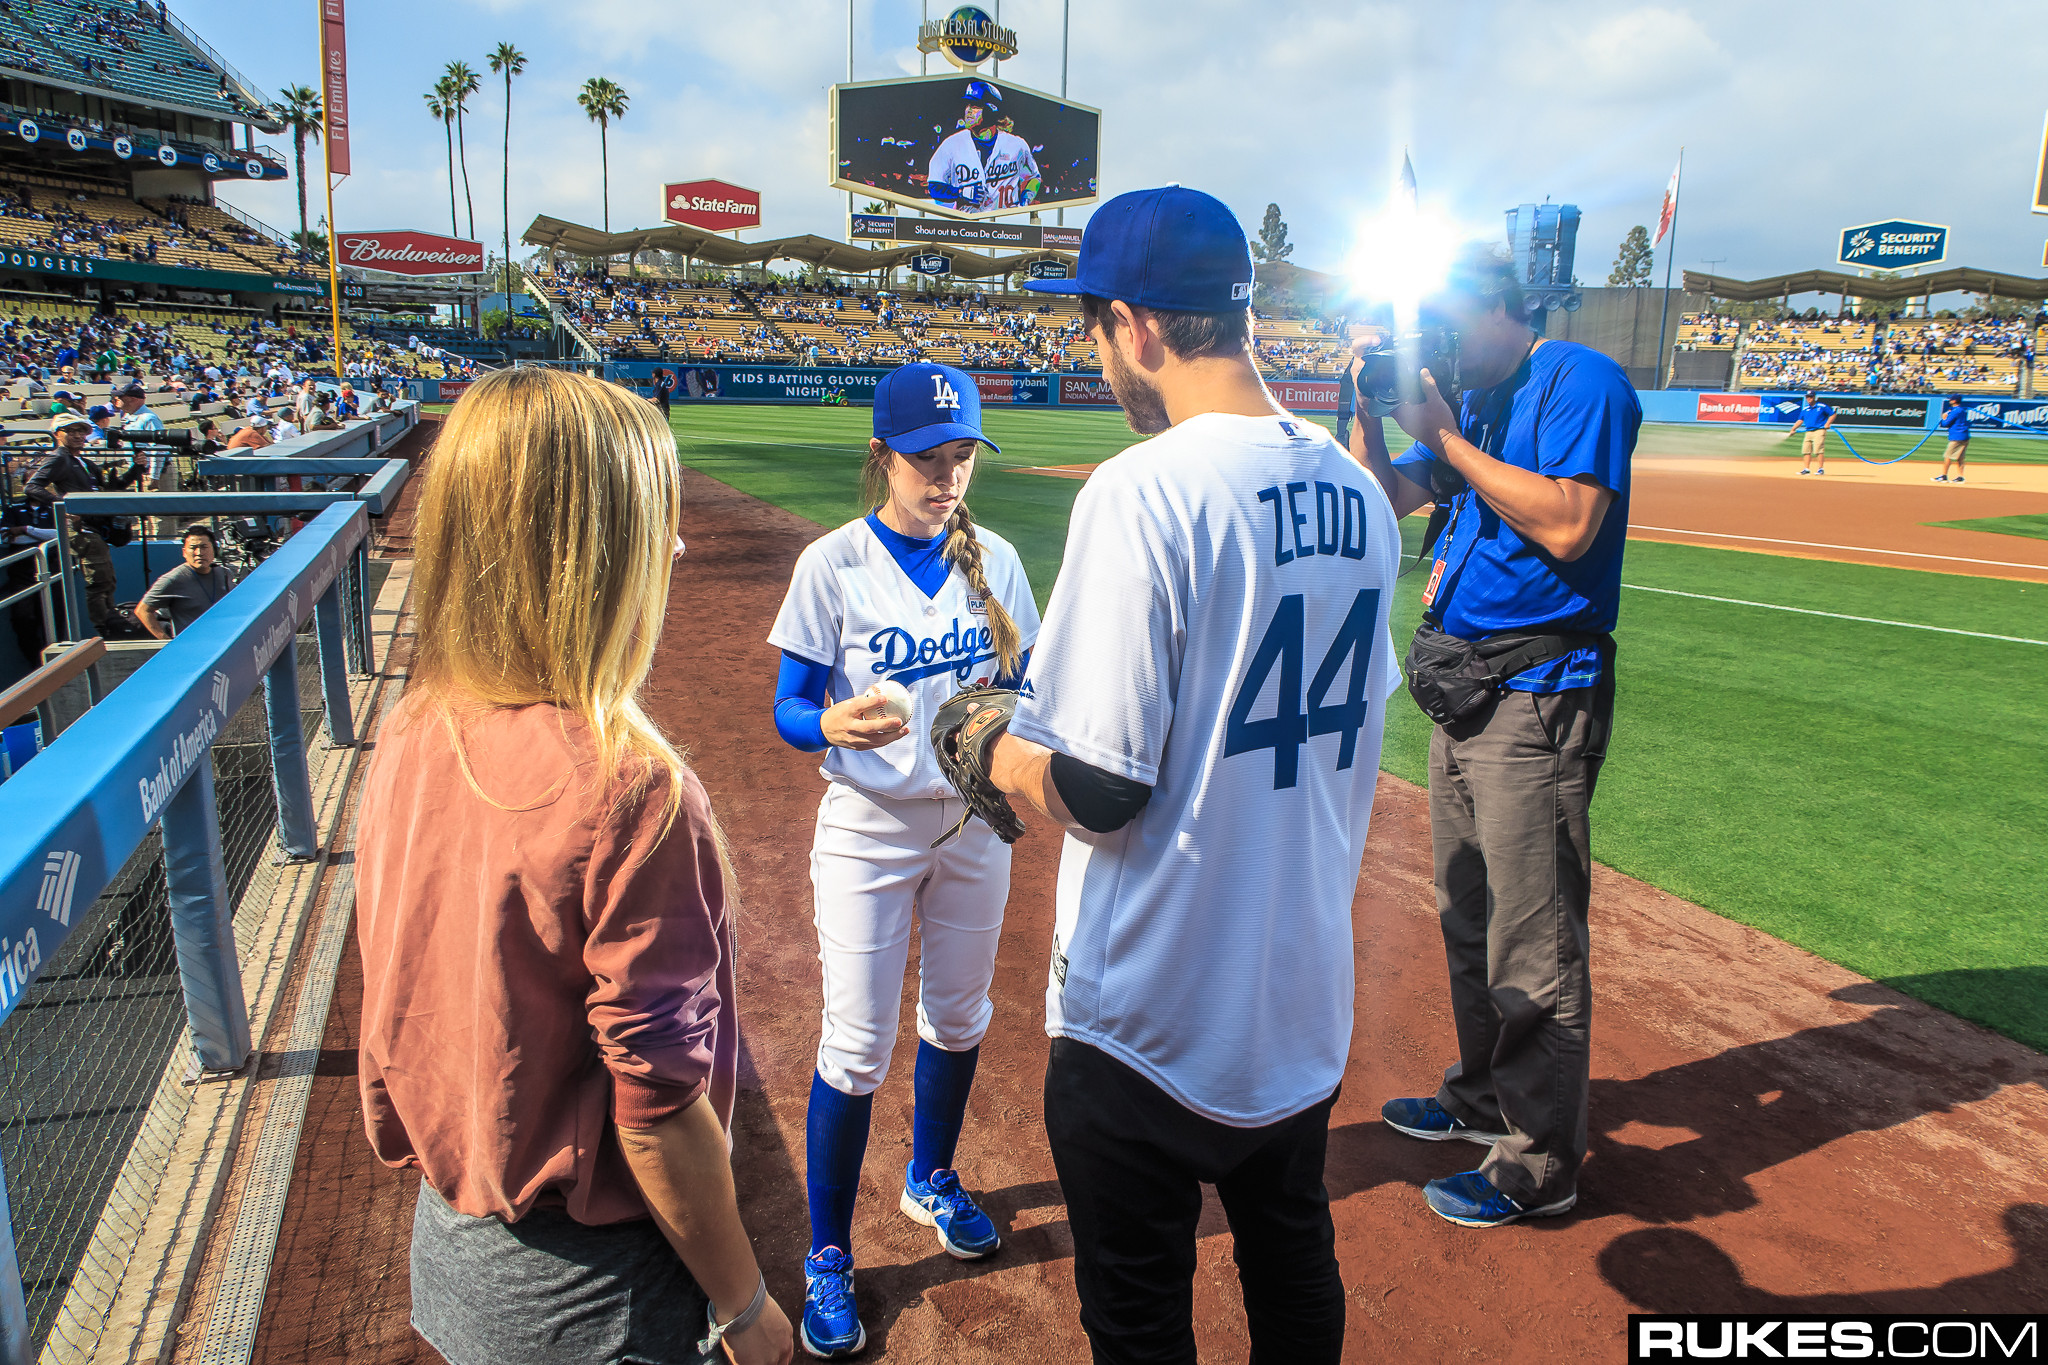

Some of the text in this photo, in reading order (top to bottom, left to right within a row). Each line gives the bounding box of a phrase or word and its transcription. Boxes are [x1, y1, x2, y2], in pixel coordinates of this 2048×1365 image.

[325, 0, 341, 17] Fl
[923, 19, 1017, 47] UNIVERSAL STUDIOS
[937, 38, 1007, 54] HOLLYWOOD
[329, 50, 347, 141] Fly Emirates
[23, 124, 36, 137] 20
[70, 134, 84, 147] 24
[117, 142, 130, 154] 32
[161, 150, 174, 161] 39
[204, 158, 218, 169] 42
[248, 163, 261, 174] 53
[955, 160, 1019, 188] Dodgers
[868, 220, 895, 228] SECURITY
[915, 224, 1022, 241] Shout out to Casa De Calacas!
[1880, 232, 1942, 244] SECURITY
[343, 238, 481, 265] Budweiser
[343, 285, 363, 297] 4:30
[732, 373, 878, 386] KIDS BATTING GLOVES
[971, 375, 1048, 389] LBmemorybank
[785, 386, 828, 397] NIGHT
[931, 374, 961, 410] LA
[1065, 381, 1089, 392] SAN
[994, 393, 1018, 401] America
[1285, 386, 1341, 402] Emirate
[1700, 402, 1775, 414] Bank of America
[1831, 405, 1923, 418] Time Warner Cable
[1256, 480, 1366, 567] ZEDD
[970, 600, 987, 609] PLAY
[1223, 588, 1381, 791] 44
[139, 708, 218, 824] Bank of America
